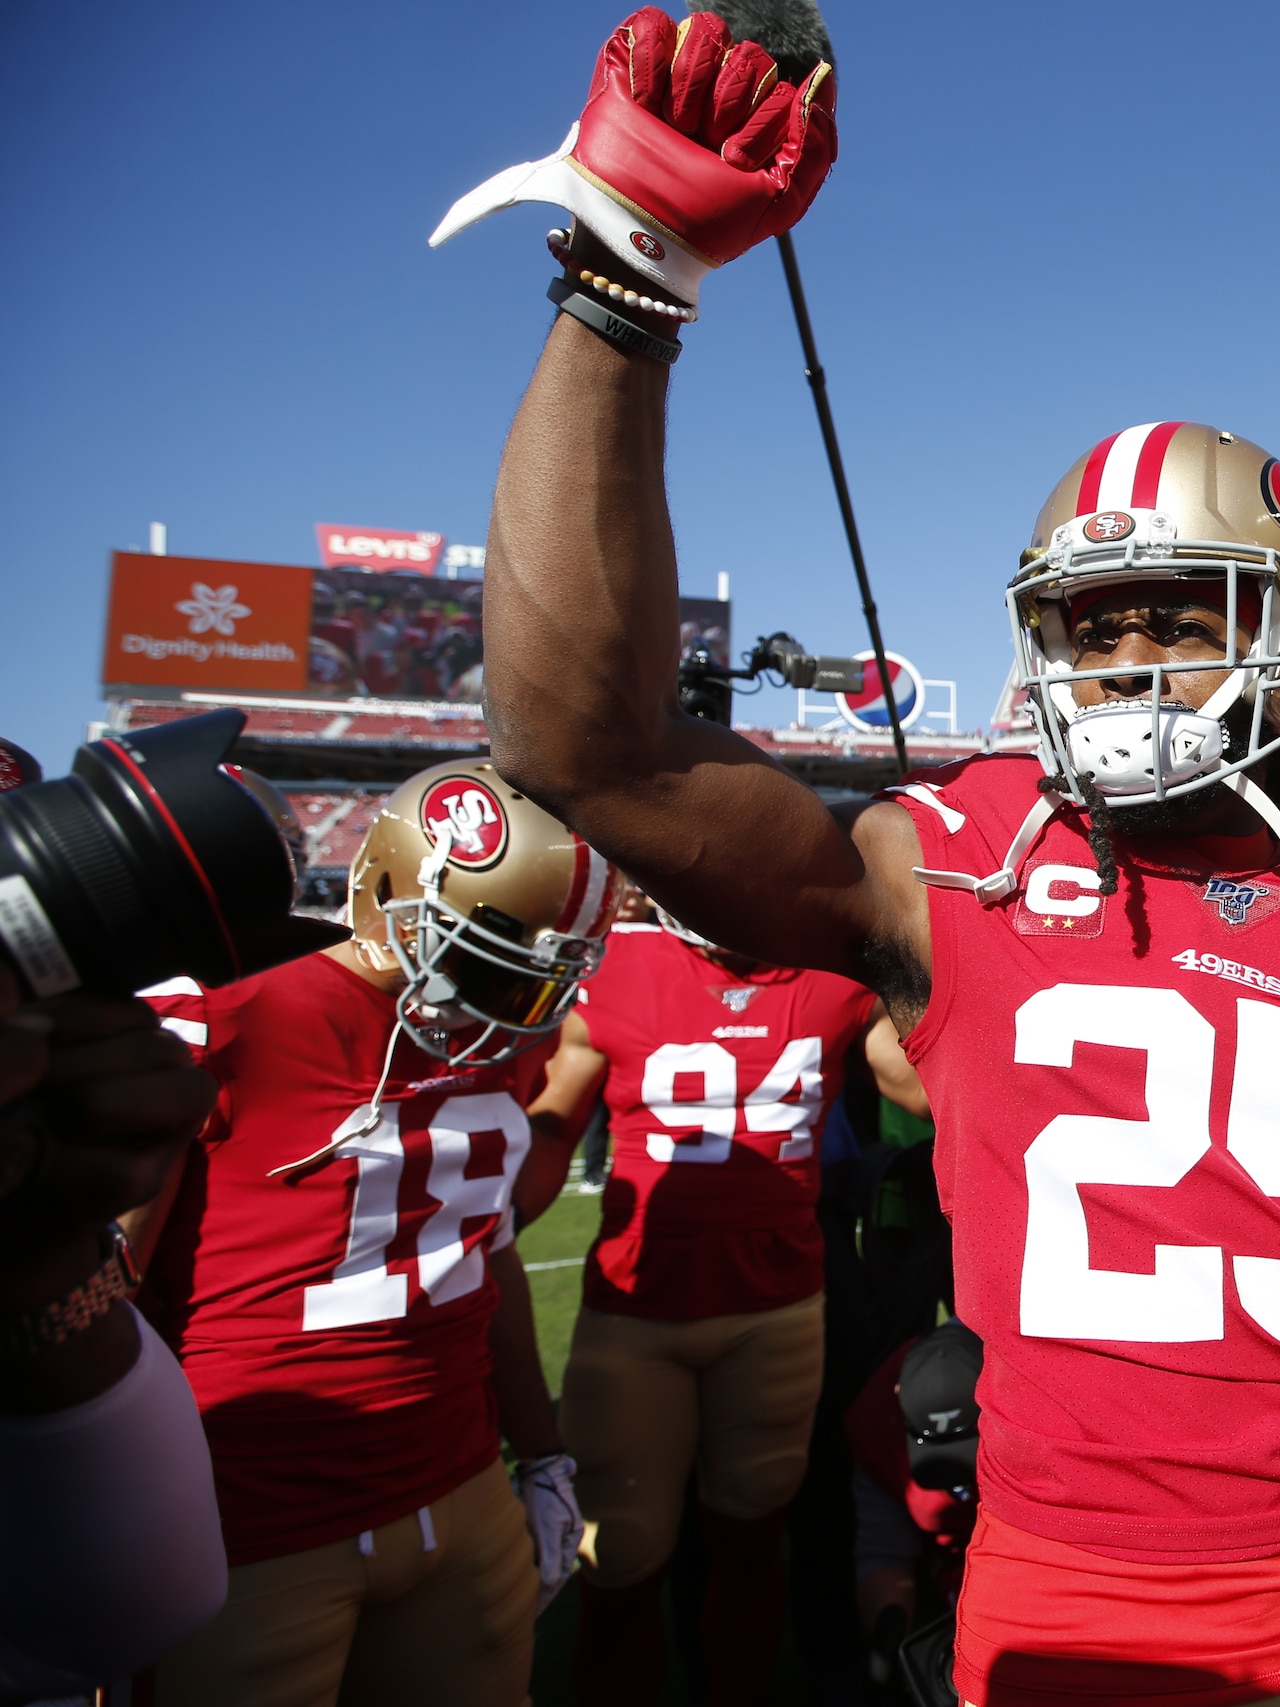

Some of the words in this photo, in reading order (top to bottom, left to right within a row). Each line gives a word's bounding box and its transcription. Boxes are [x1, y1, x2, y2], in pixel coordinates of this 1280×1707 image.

[1095, 514, 1125, 538] SF
[122, 634, 213, 662] Dignity
[214, 640, 296, 662] Health
[1025, 864, 1101, 917] C
[641, 1036, 824, 1164] 94
[302, 1091, 532, 1331] 18
